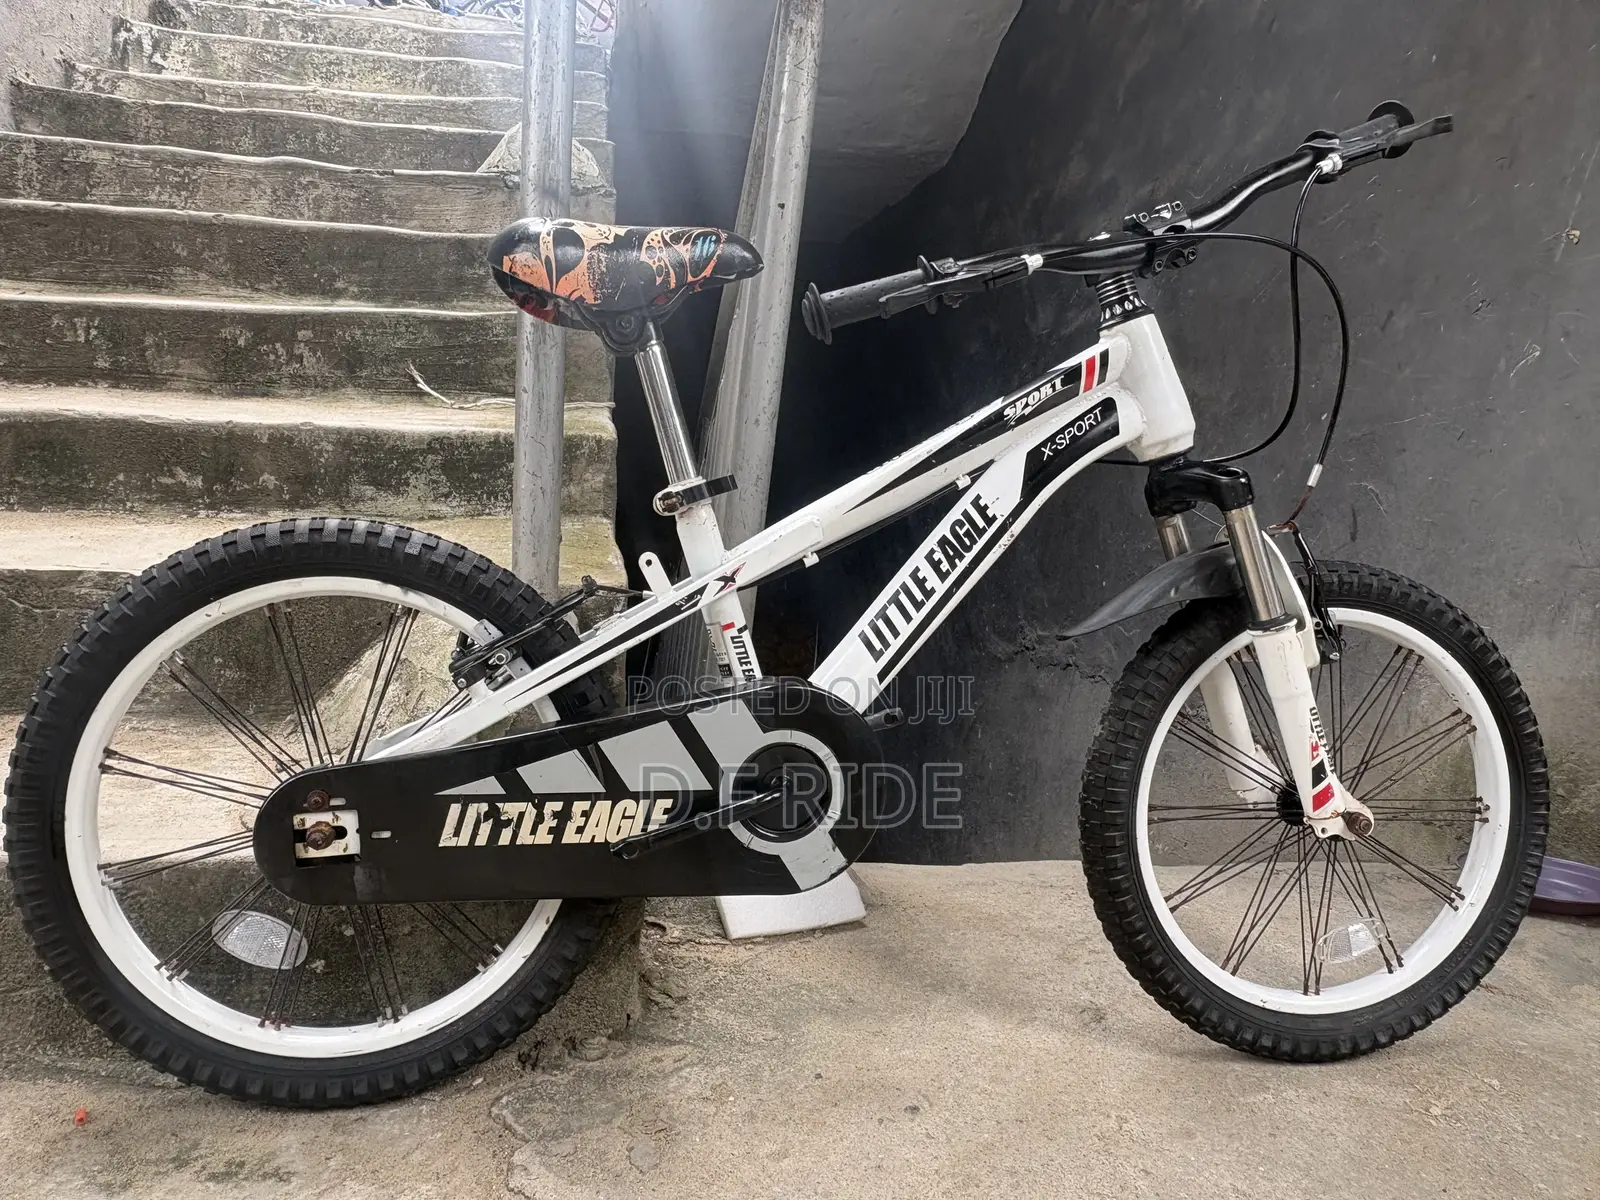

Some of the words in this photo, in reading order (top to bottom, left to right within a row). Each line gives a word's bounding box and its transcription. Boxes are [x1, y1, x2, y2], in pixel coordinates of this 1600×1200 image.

[1003, 375, 1064, 420] SPORT
[1041, 407, 1102, 461] X-SPORT
[858, 566, 936, 663] LITTLE
[924, 493, 998, 584] EAGLE
[730, 635, 752, 668] LITTLE
[438, 801, 563, 847] LITTLE
[561, 799, 673, 843] EAGLE
